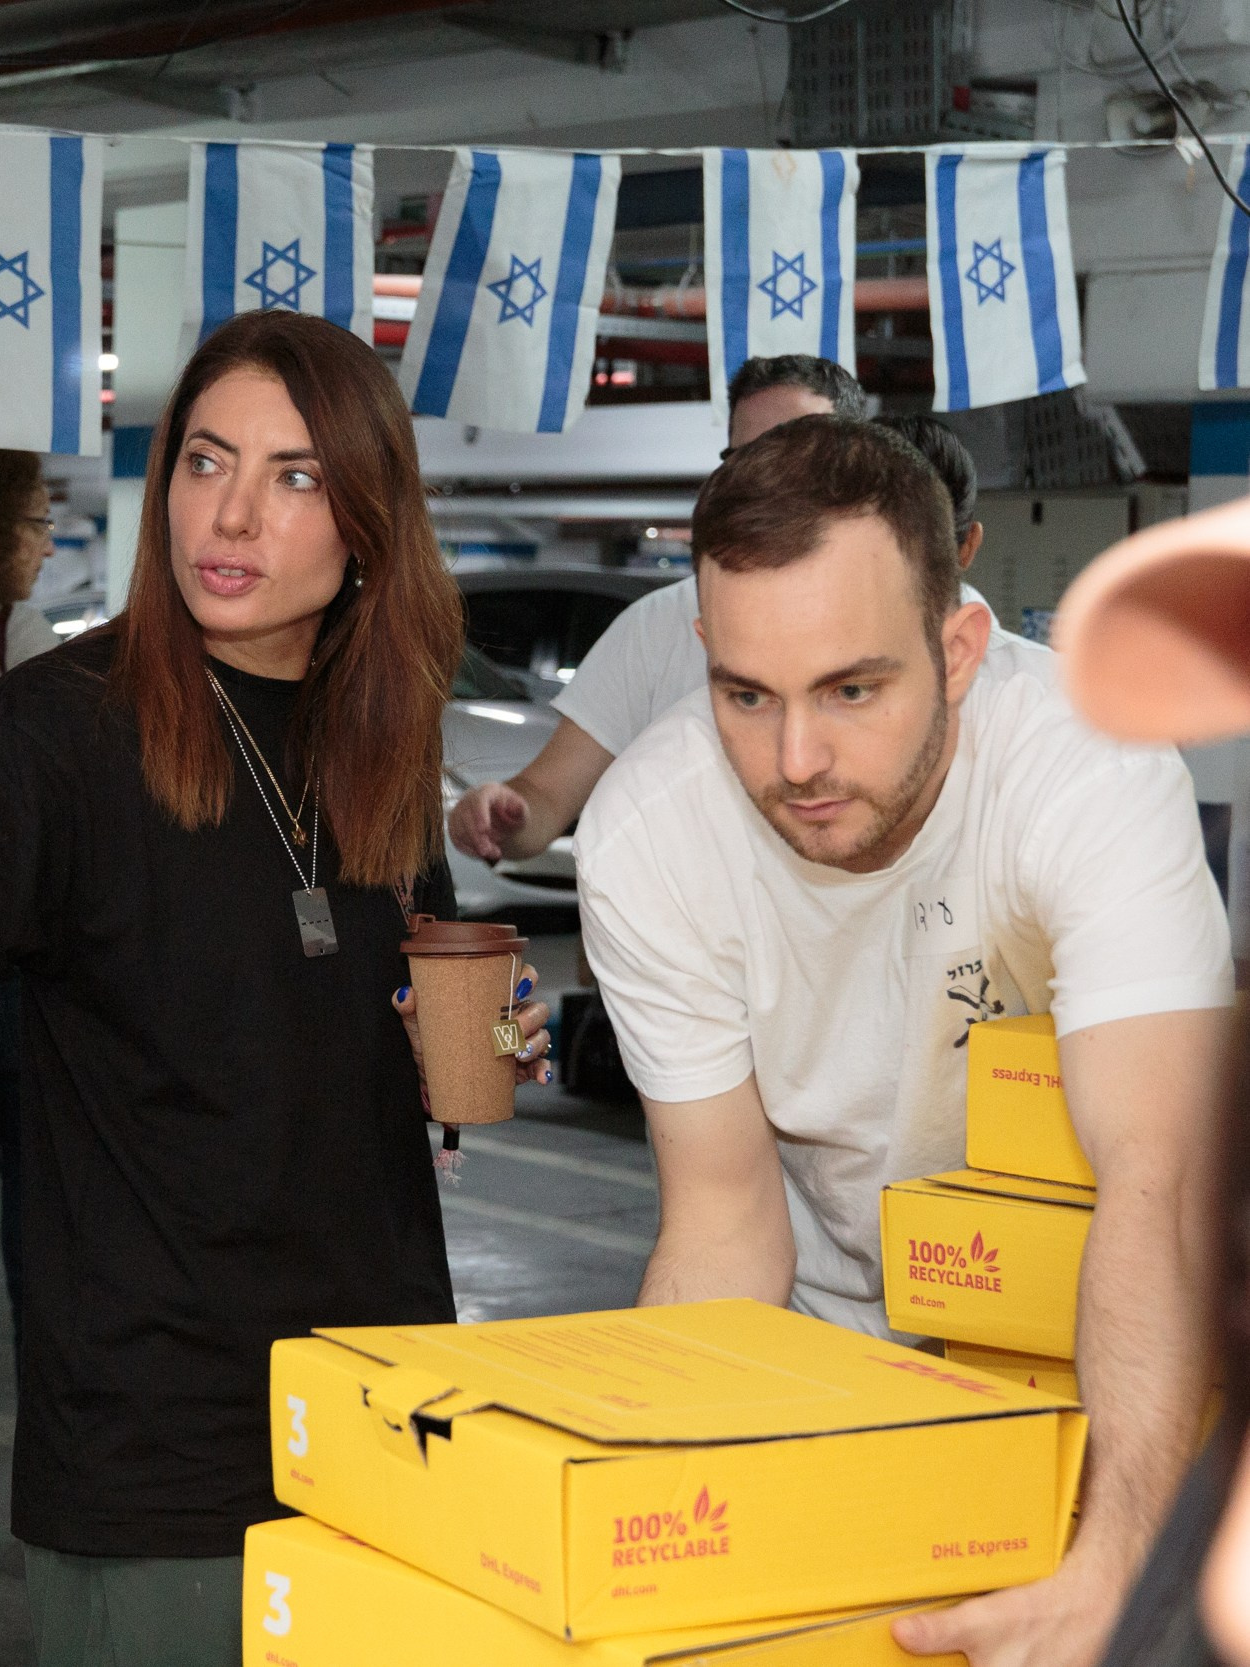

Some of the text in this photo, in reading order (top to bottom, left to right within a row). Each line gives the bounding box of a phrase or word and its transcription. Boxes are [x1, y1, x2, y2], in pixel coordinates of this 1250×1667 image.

[991, 1067, 1063, 1089] HL Express
[908, 1239, 967, 1269] 100%
[909, 1264, 1002, 1293] RECYCLABLE
[910, 1295, 946, 1309] dhl.com
[286, 1393, 308, 1457] 3
[613, 1509, 688, 1544] 100%
[612, 1535, 730, 1568] RECYCLABLE
[931, 1537, 1029, 1560] DHL Express
[479, 1551, 542, 1593] DHL Express
[262, 1569, 292, 1637] 3
[611, 1583, 657, 1599] dhl.com
